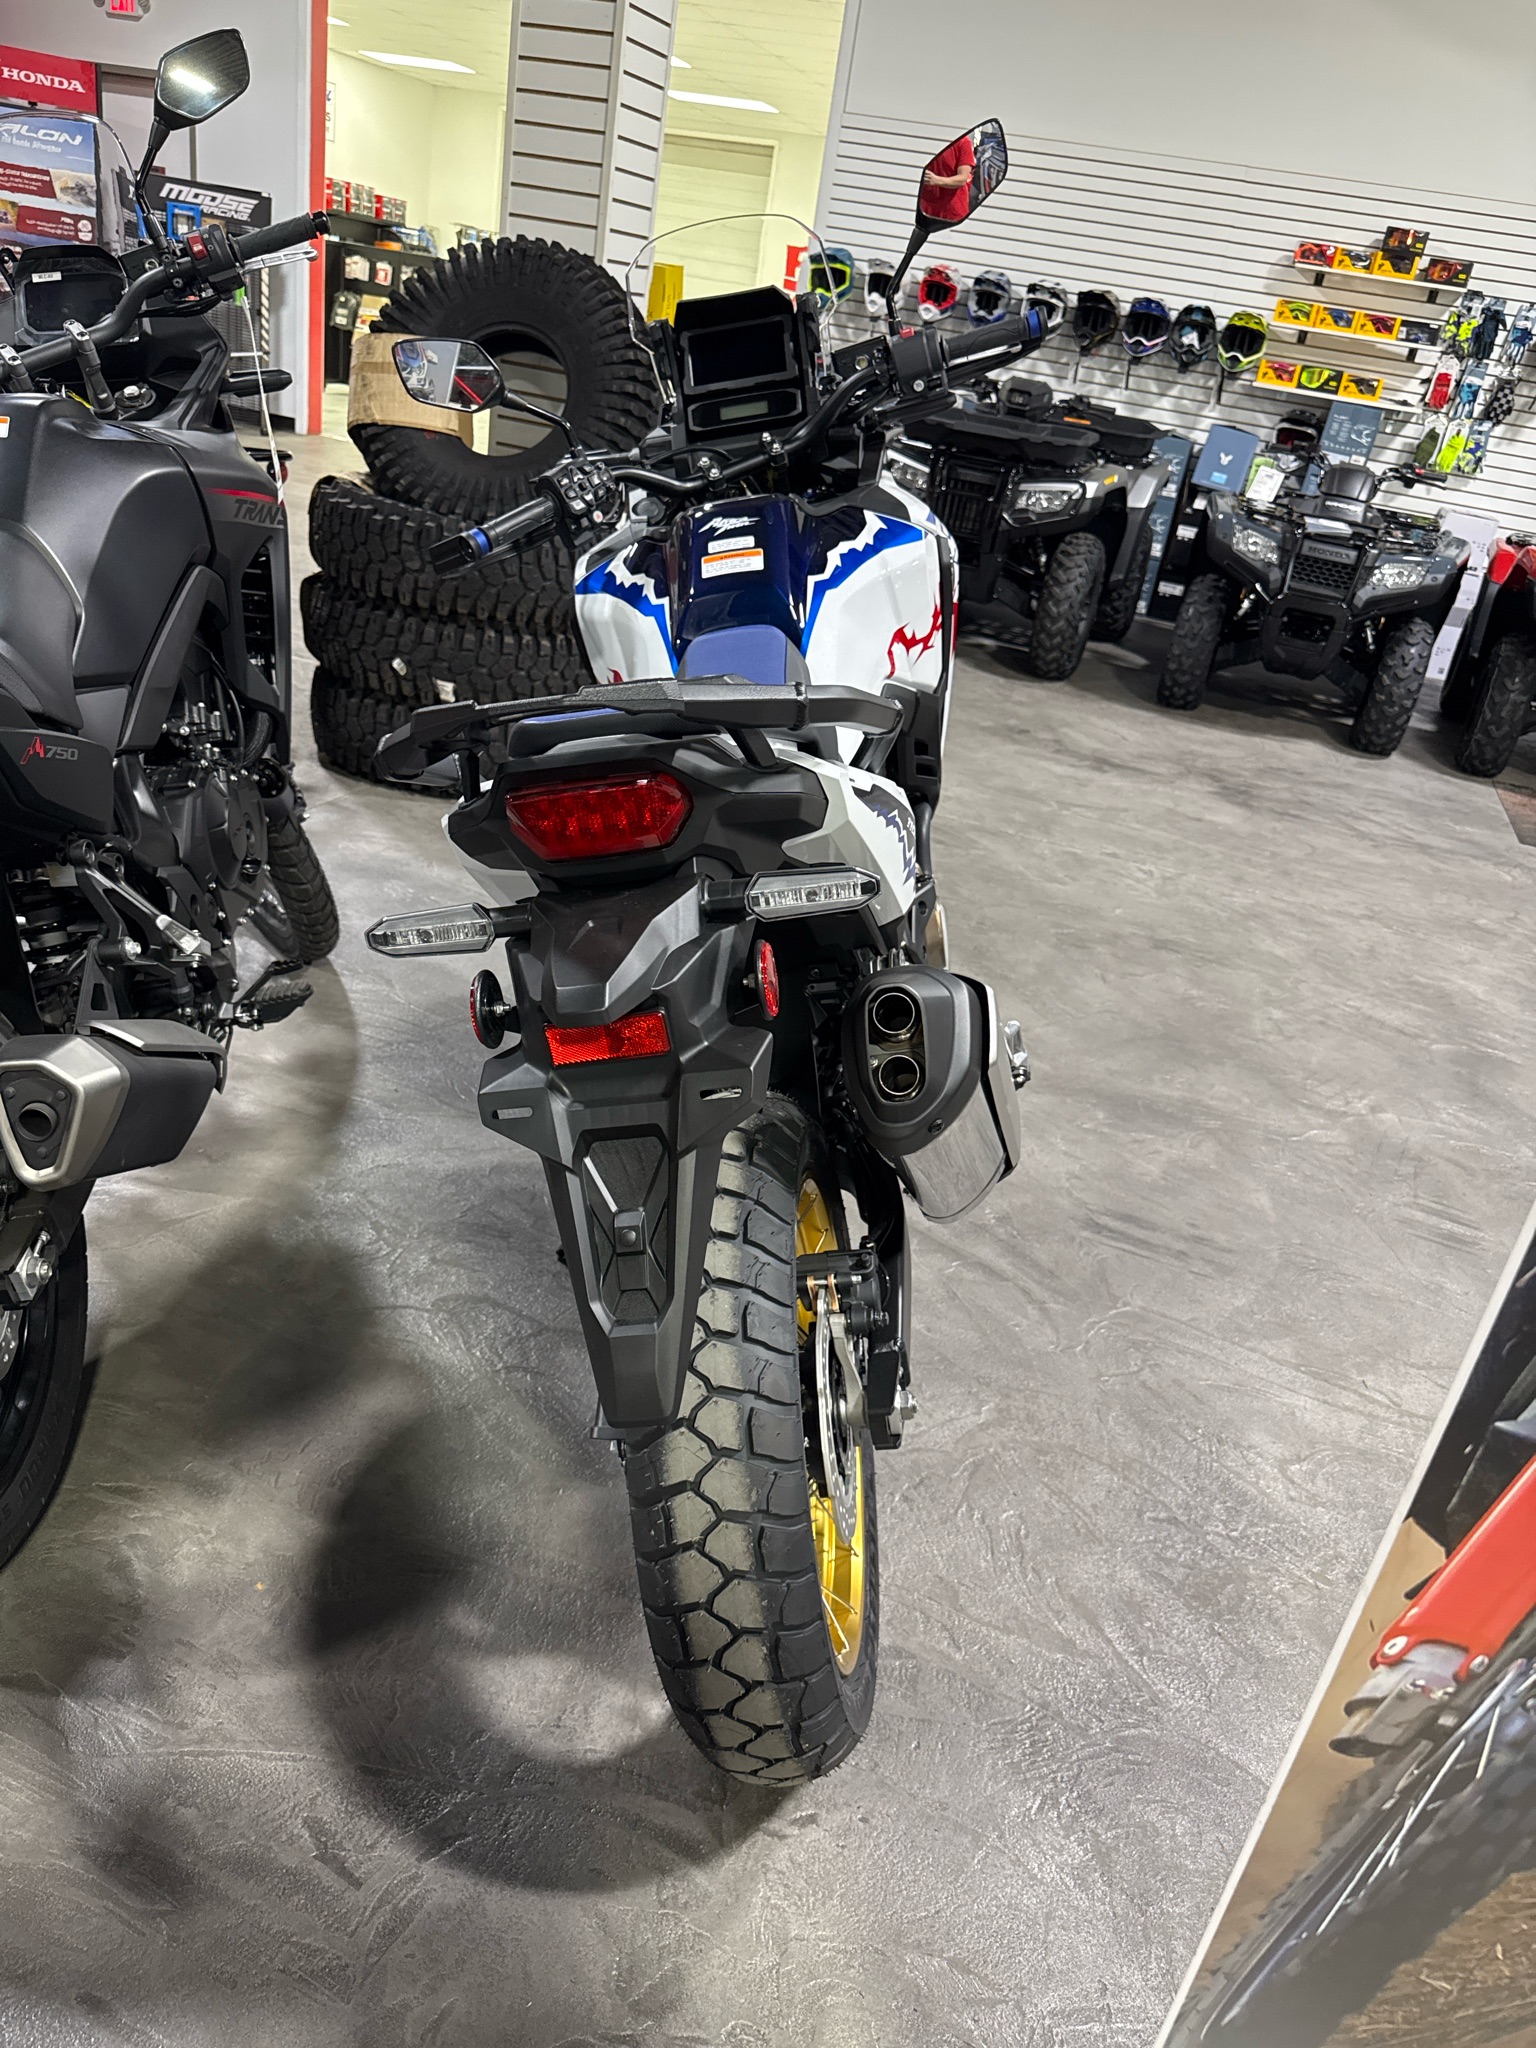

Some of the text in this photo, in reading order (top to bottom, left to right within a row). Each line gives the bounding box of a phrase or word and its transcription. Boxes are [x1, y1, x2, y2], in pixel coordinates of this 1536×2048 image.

[1, 66, 86, 93] HONDA
[0, 122, 83, 146] ALON
[159, 182, 259, 213] MOOSE
[201, 205, 250, 221] RACING
[45, 745, 79, 761] 750
